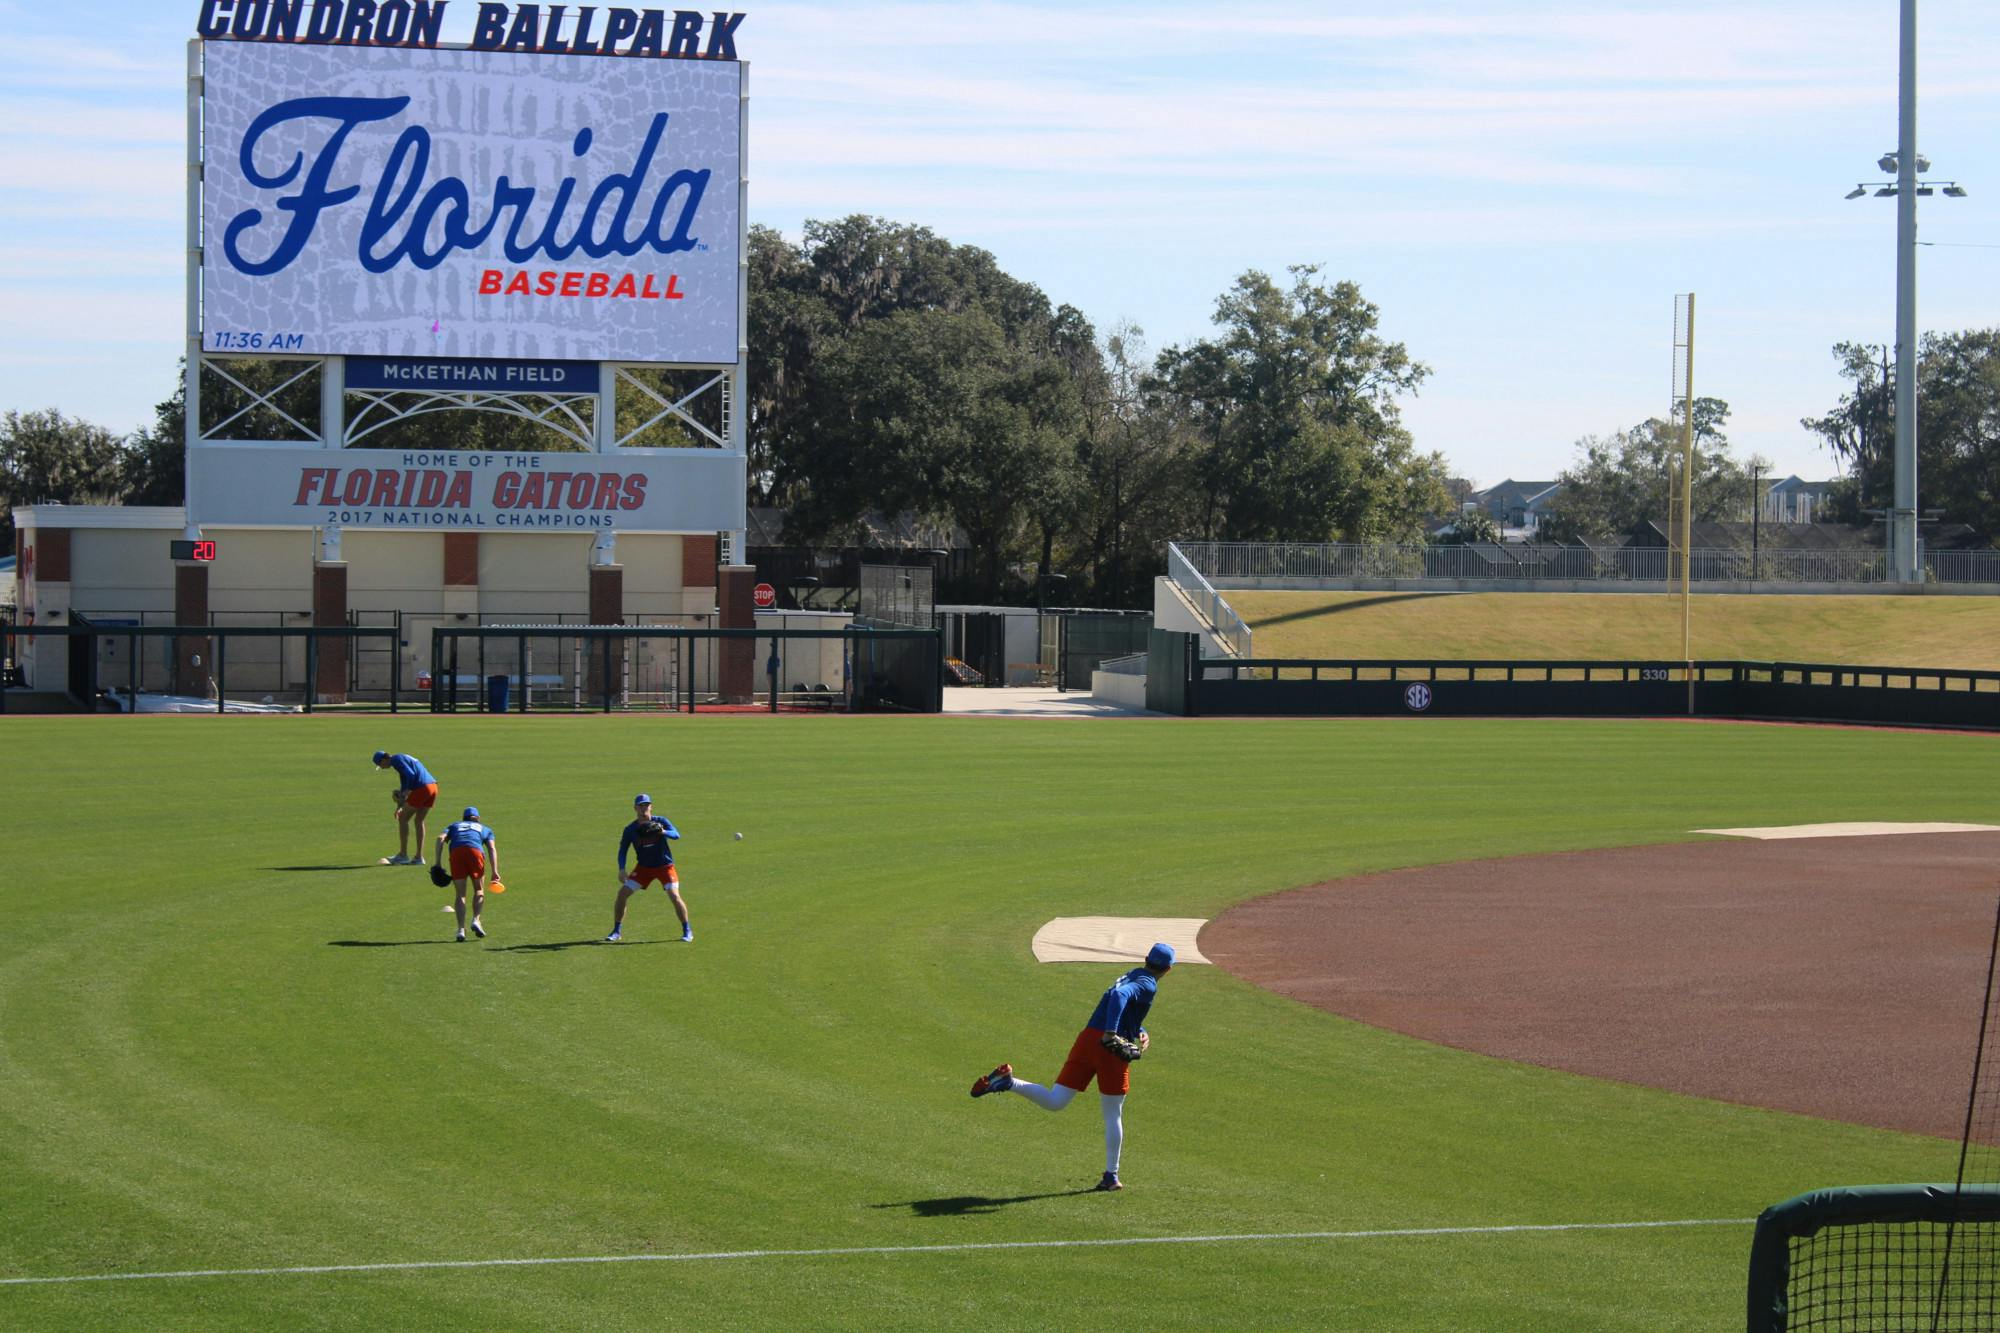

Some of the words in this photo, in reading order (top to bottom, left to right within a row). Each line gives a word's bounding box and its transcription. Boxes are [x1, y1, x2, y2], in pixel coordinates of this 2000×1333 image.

[197, 0, 450, 49] CONDRON
[474, 2, 747, 59] BALLPARK
[223, 96, 711, 276] Florida
[478, 269, 685, 299] BASEBALL
[215, 332, 263, 348] 11:36
[268, 333, 304, 349] AM
[383, 364, 497, 380] McKETHAN
[506, 367, 566, 382] FIELD
[403, 454, 458, 467] HOME
[469, 455, 494, 467] OF
[504, 456, 541, 468] THE
[292, 467, 473, 508] FLORIDA
[492, 471, 648, 510] GATORS
[328, 511, 373, 523] 2017
[383, 512, 485, 525] NATIONAL
[496, 513, 613, 526] CHAMPIONS
[193, 541, 215, 560] 20
[753, 590, 774, 600] STOP
[1642, 669, 1667, 680] 330
[1407, 684, 1429, 708] SEC
